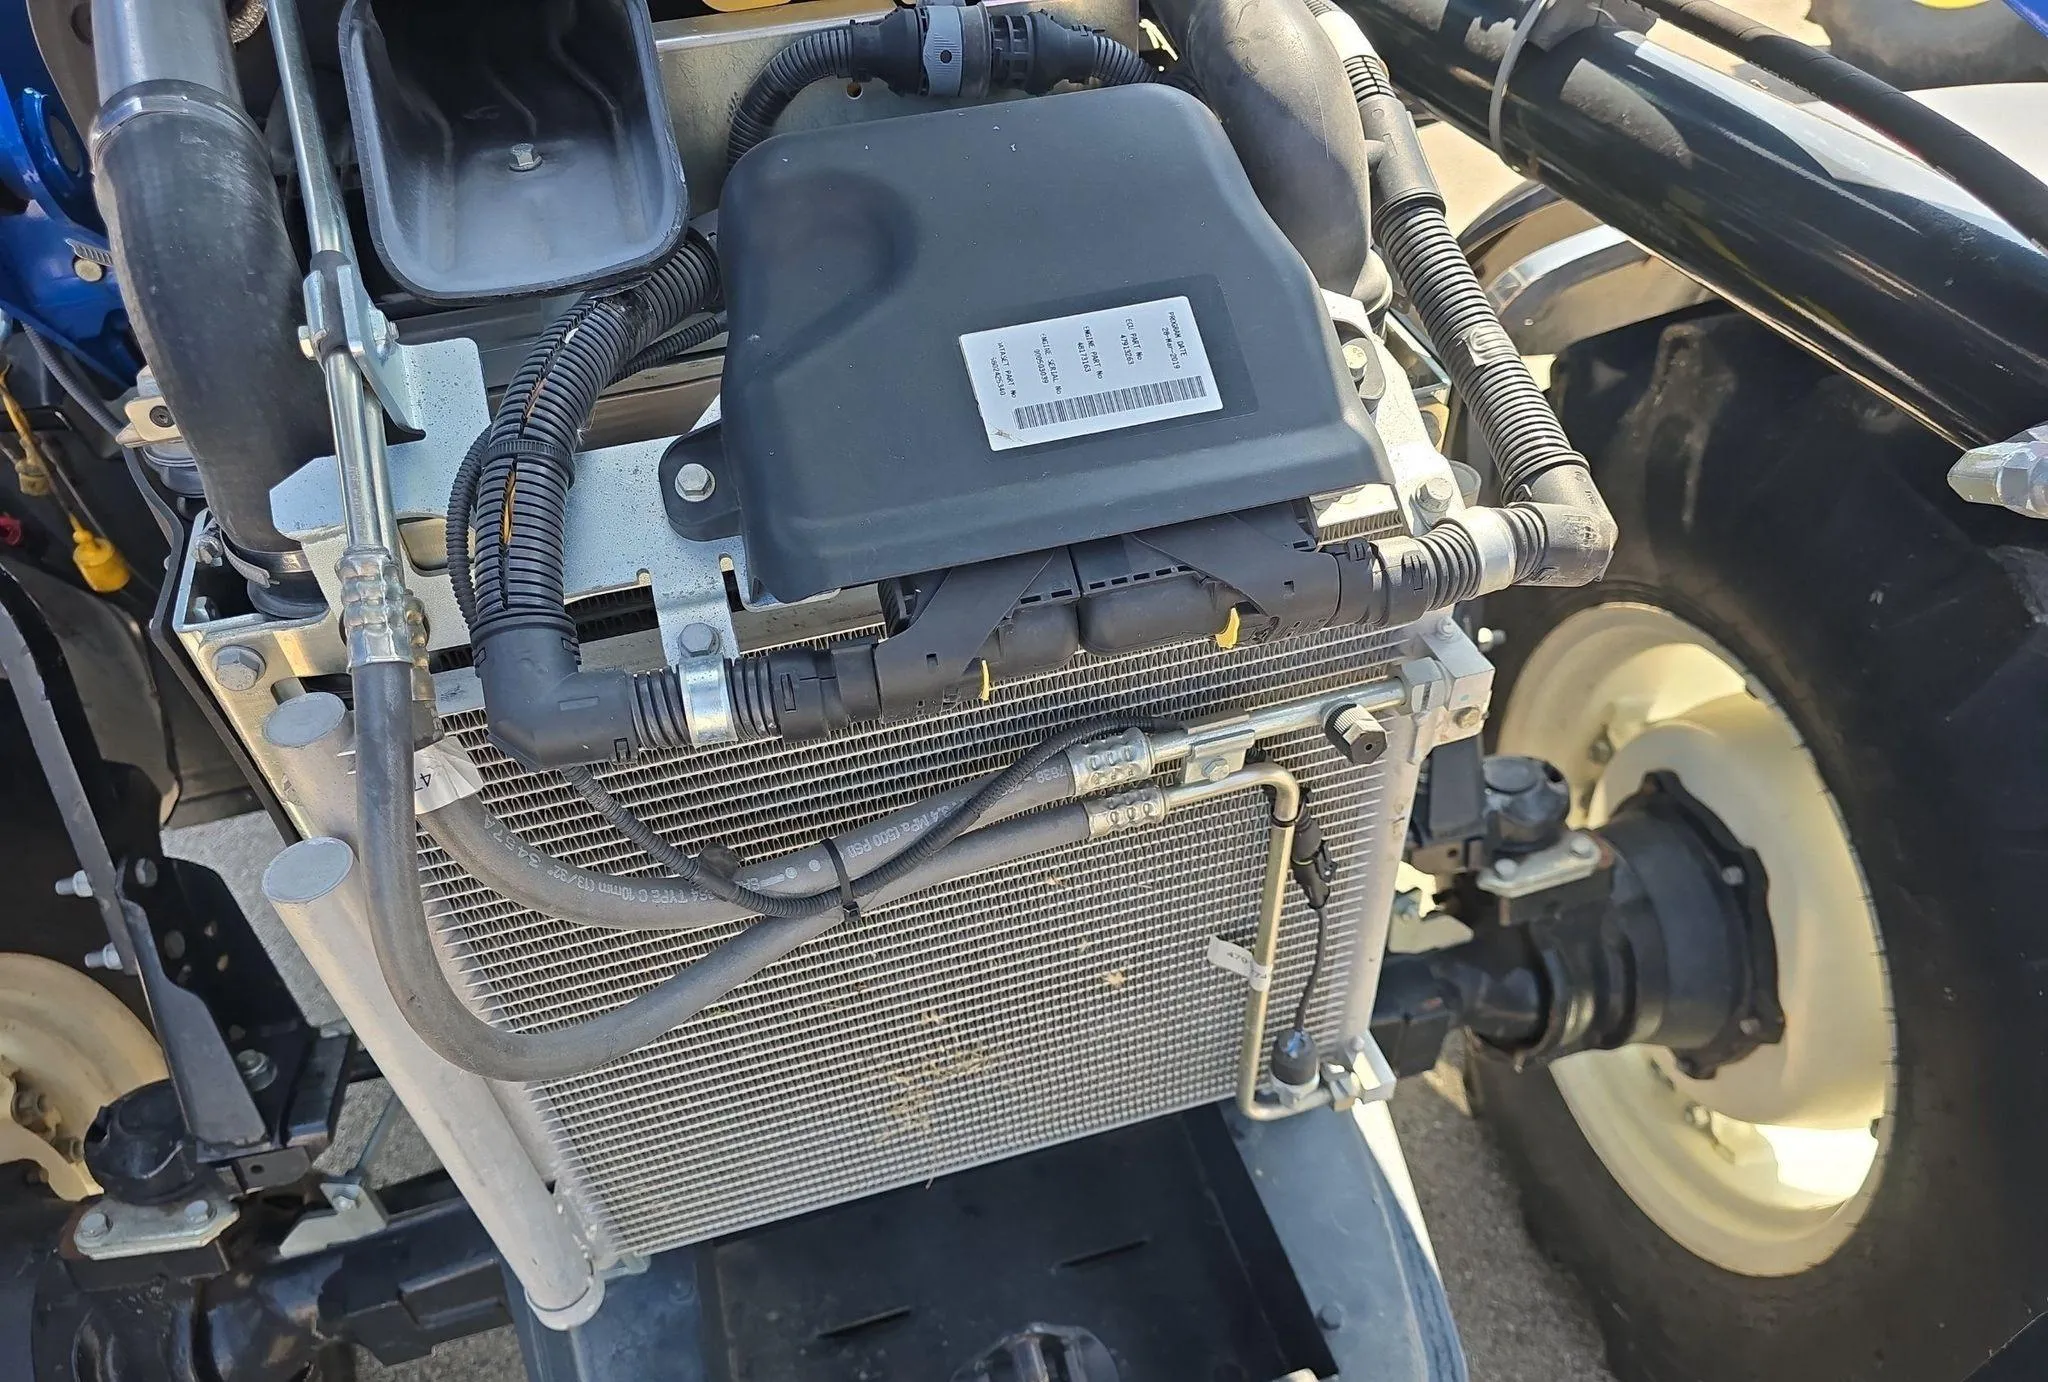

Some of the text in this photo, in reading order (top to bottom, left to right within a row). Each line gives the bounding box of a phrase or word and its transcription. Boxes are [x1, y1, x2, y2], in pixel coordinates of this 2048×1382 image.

[1125, 318, 1135, 331] ECU
[1130, 332, 1142, 349] PART
[1168, 311, 1187, 356] PROGRAM DATE
[1083, 325, 1104, 380] ENGINE PART No
[1120, 334, 1135, 365] 47913263
[1004, 370, 1016, 387] PART
[1048, 359, 1060, 382] SERIAL
[1055, 385, 1062, 395] No
[1035, 764, 1067, 784] 7638
[650, 889, 689, 904] TYPE
